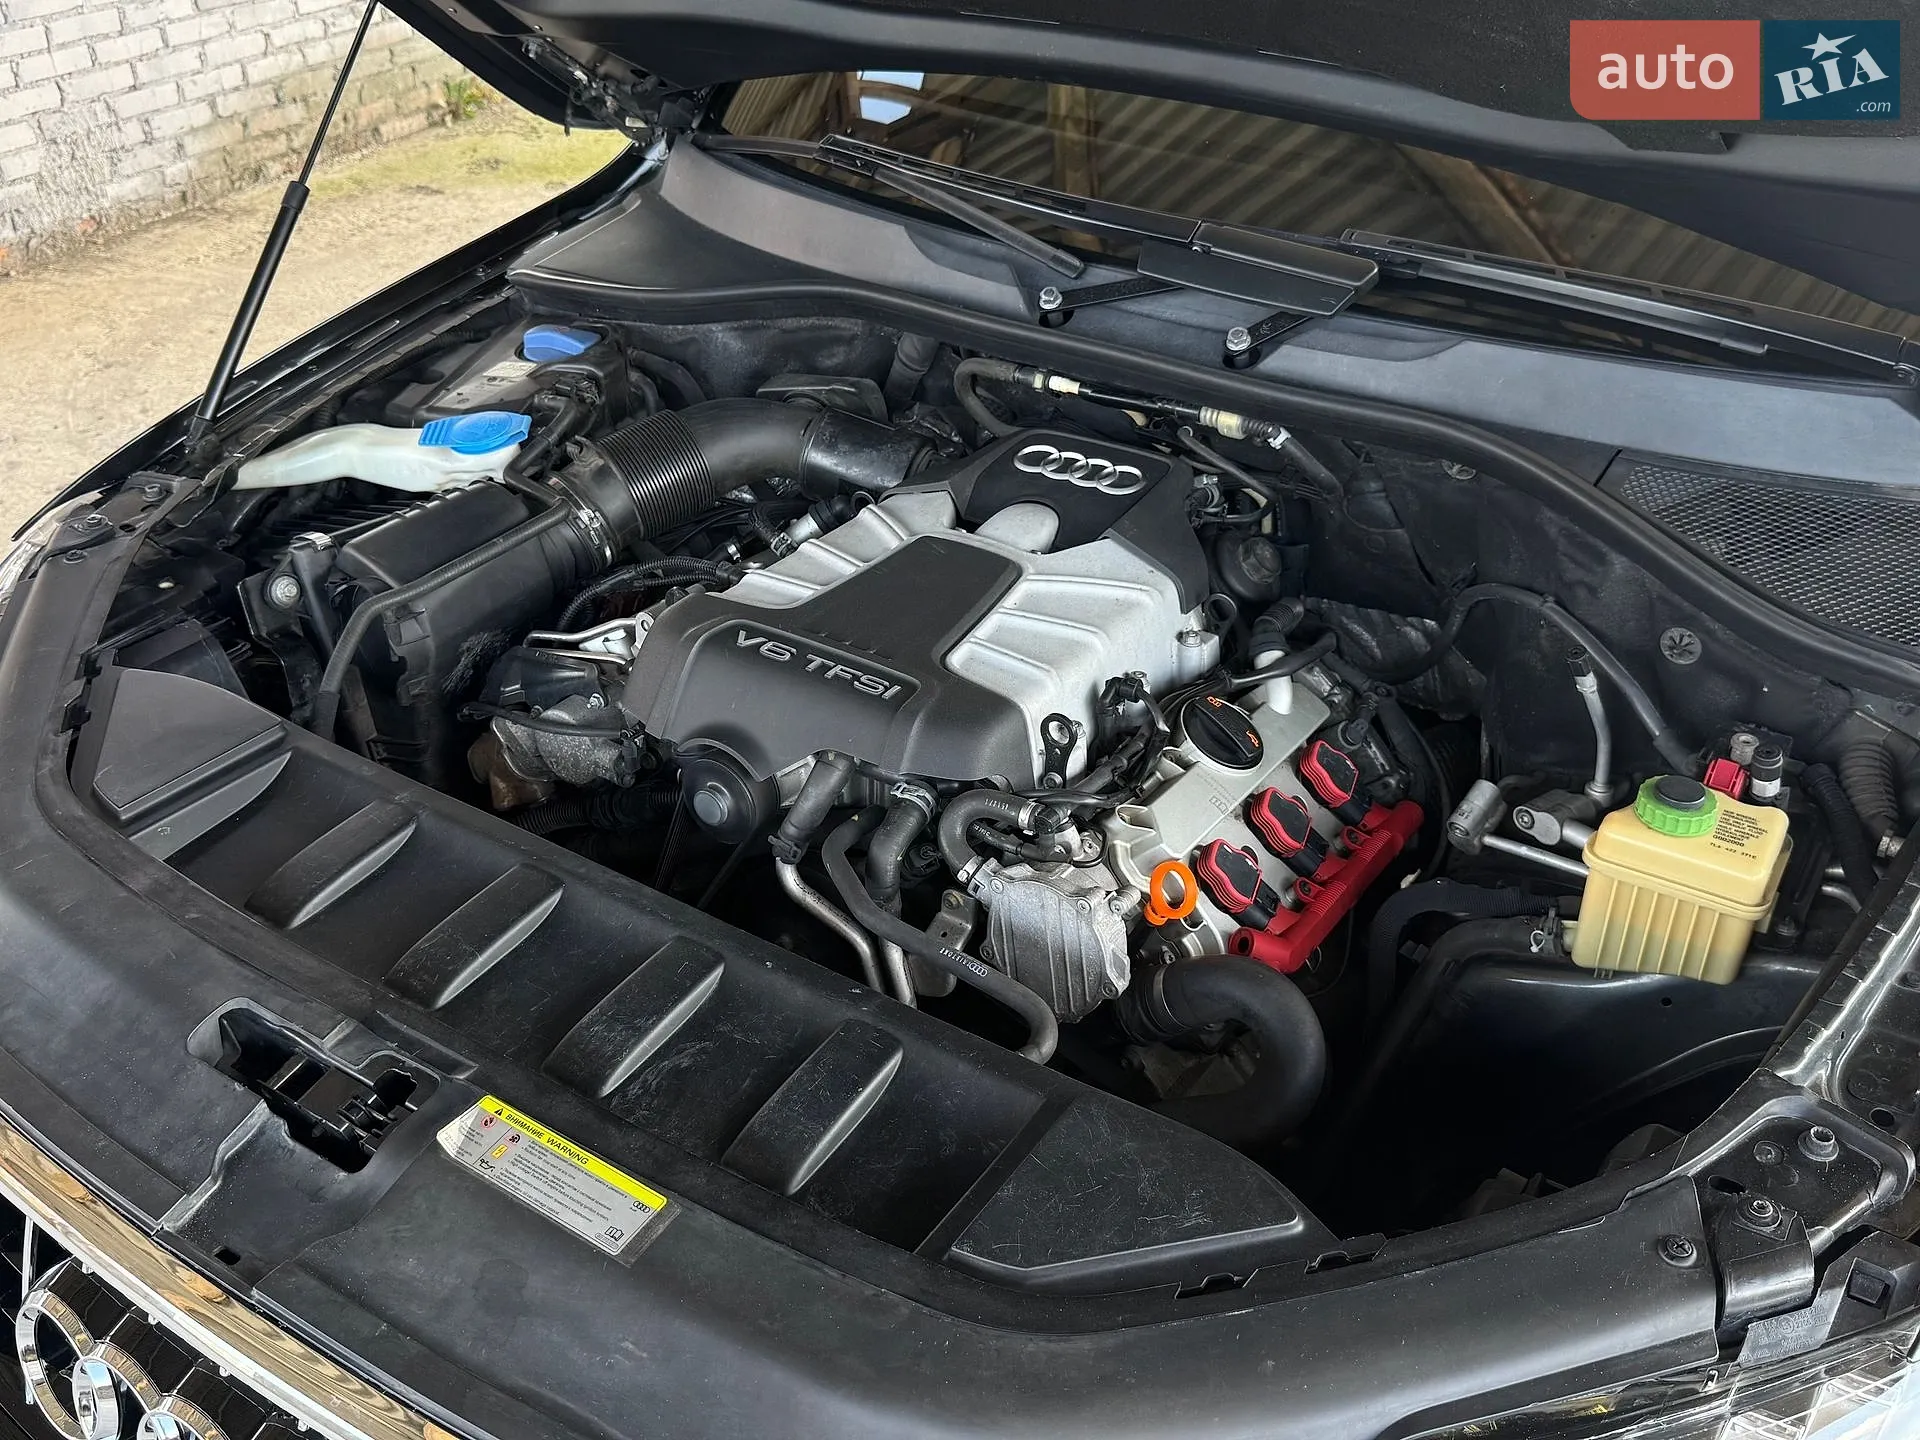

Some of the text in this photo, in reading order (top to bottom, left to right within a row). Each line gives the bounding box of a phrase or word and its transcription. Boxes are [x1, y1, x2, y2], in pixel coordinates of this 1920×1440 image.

[736, 629, 903, 700] V6 TFSI
[505, 1113, 589, 1165] ВНИМАНИЕ WARNING
